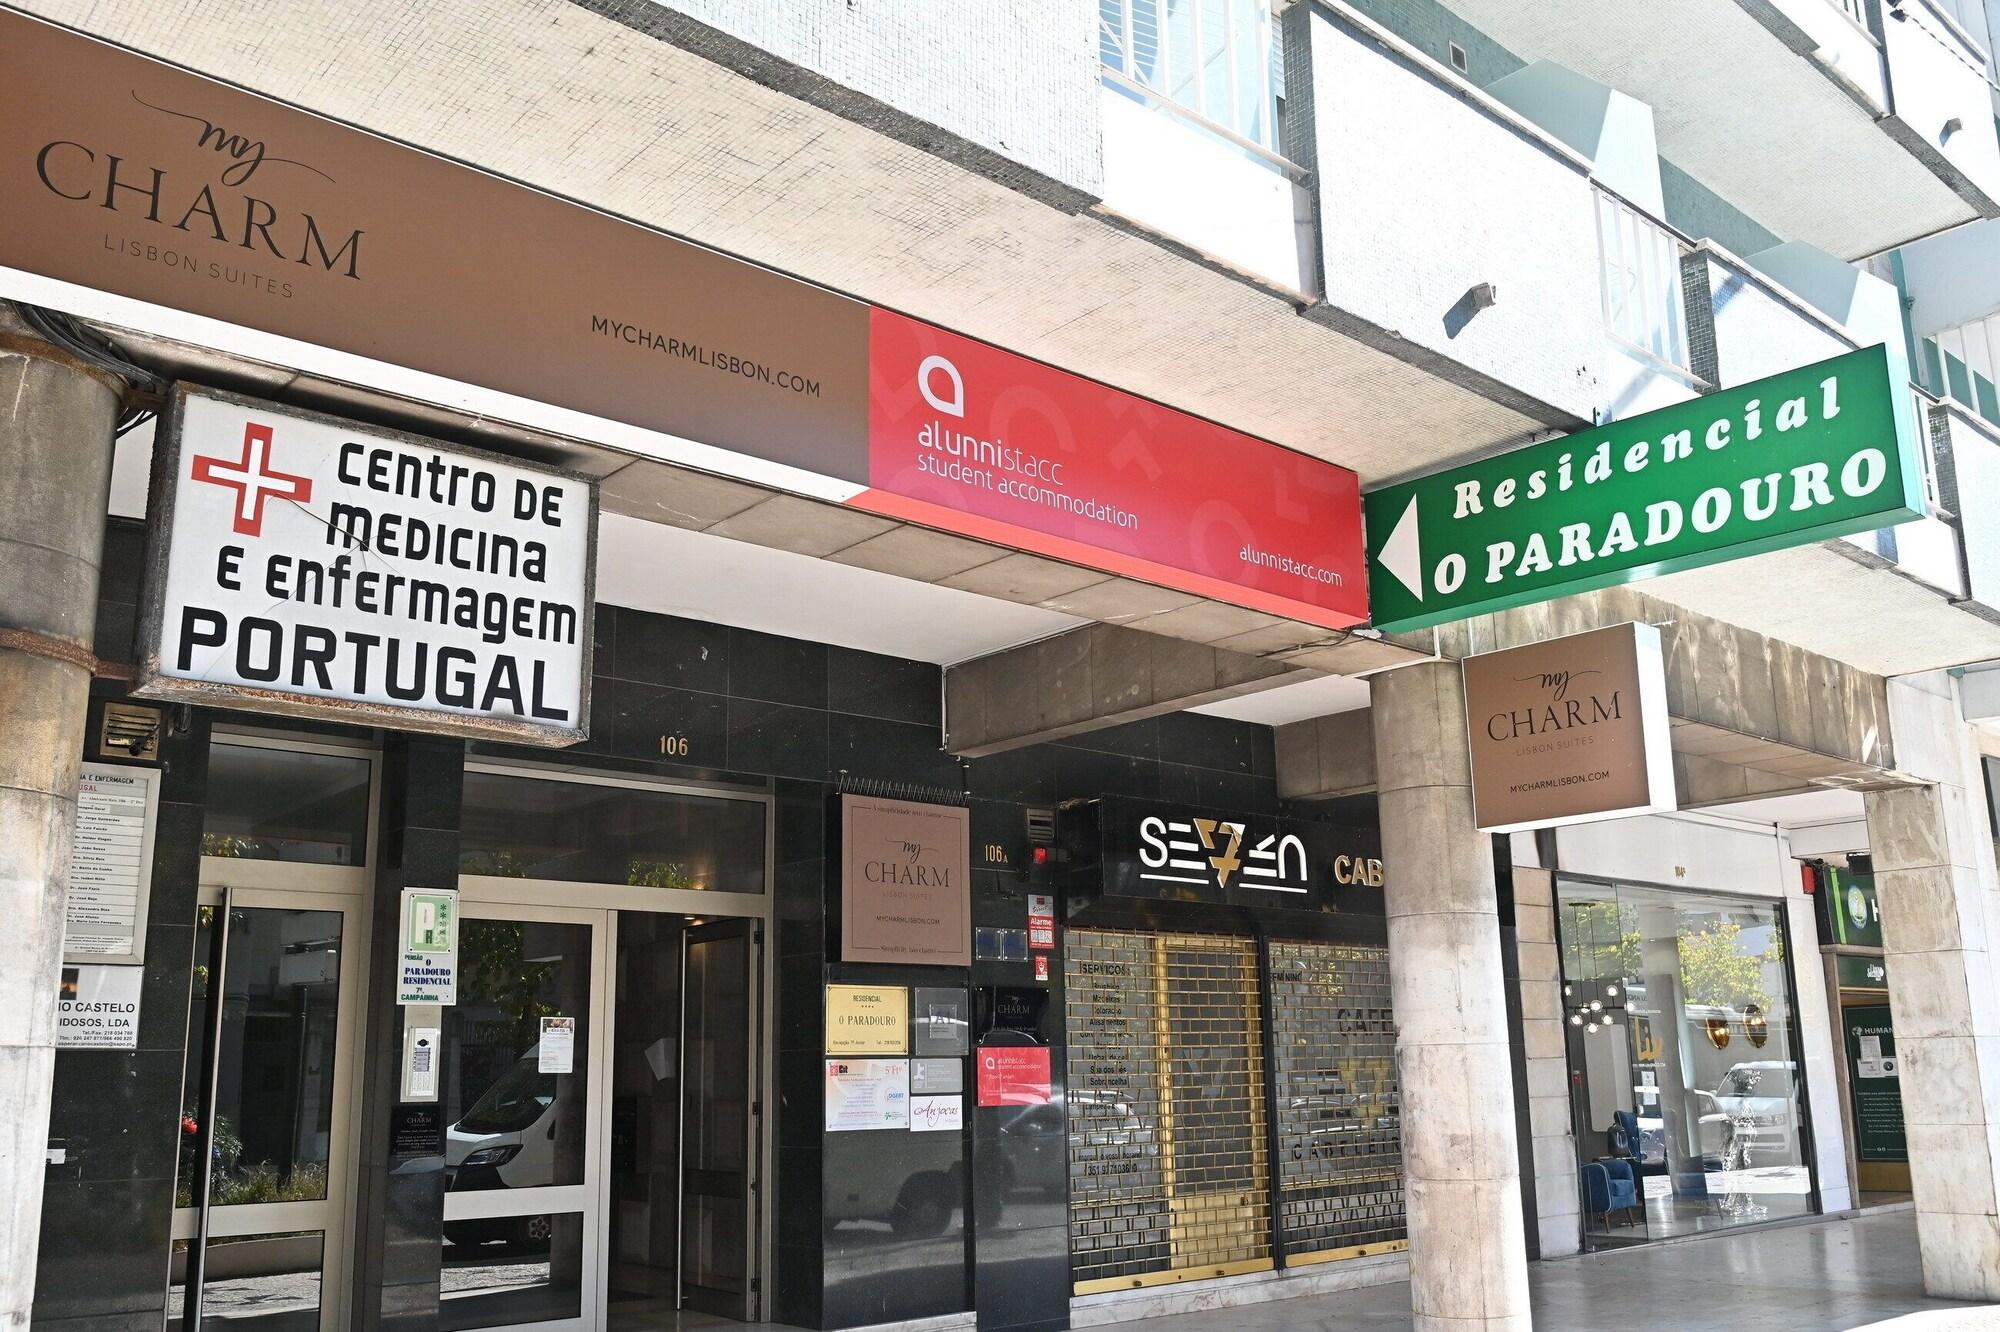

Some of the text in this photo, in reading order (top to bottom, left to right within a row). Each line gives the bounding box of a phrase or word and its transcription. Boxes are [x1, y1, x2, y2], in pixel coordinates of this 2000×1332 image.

[36, 140, 365, 281] CHARM
[103, 233, 295, 299] LISBON SUITES
[591, 314, 821, 398] MYCHARMLISBON.COM
[917, 420, 1064, 487] alunnistacc
[1453, 375, 1842, 519] Residencial
[513, 478, 565, 528] DE
[917, 451, 1139, 531] student accommodation
[1433, 447, 1889, 595] O PARADOURO
[216, 545, 245, 591] E
[1238, 543, 1343, 588] alunnistacc.com
[176, 605, 569, 722] PORTUGAL
[1487, 690, 1623, 742] CHARM
[660, 735, 689, 756] 106
[1515, 735, 1595, 757] LISBON SUITES
[95, 775, 134, 785] ENFERMAGEM
[1509, 770, 1611, 793] MYCHARMLISBON.COM
[864, 861, 951, 888] CHARM
[1030, 917, 1053, 926] Alarme
[403, 976, 452, 985] RESIDENCIAL
[404, 967, 451, 976] PARADOURO
[75, 1002, 135, 1013] CASTELO
[401, 993, 439, 1001] CAMPAINHA
[853, 994, 882, 1003] RESIDENCIAL
[997, 1004, 1030, 1015] CHARM
[107, 1018, 130, 1028] LDA
[838, 1015, 896, 1026] O PARADOURO
